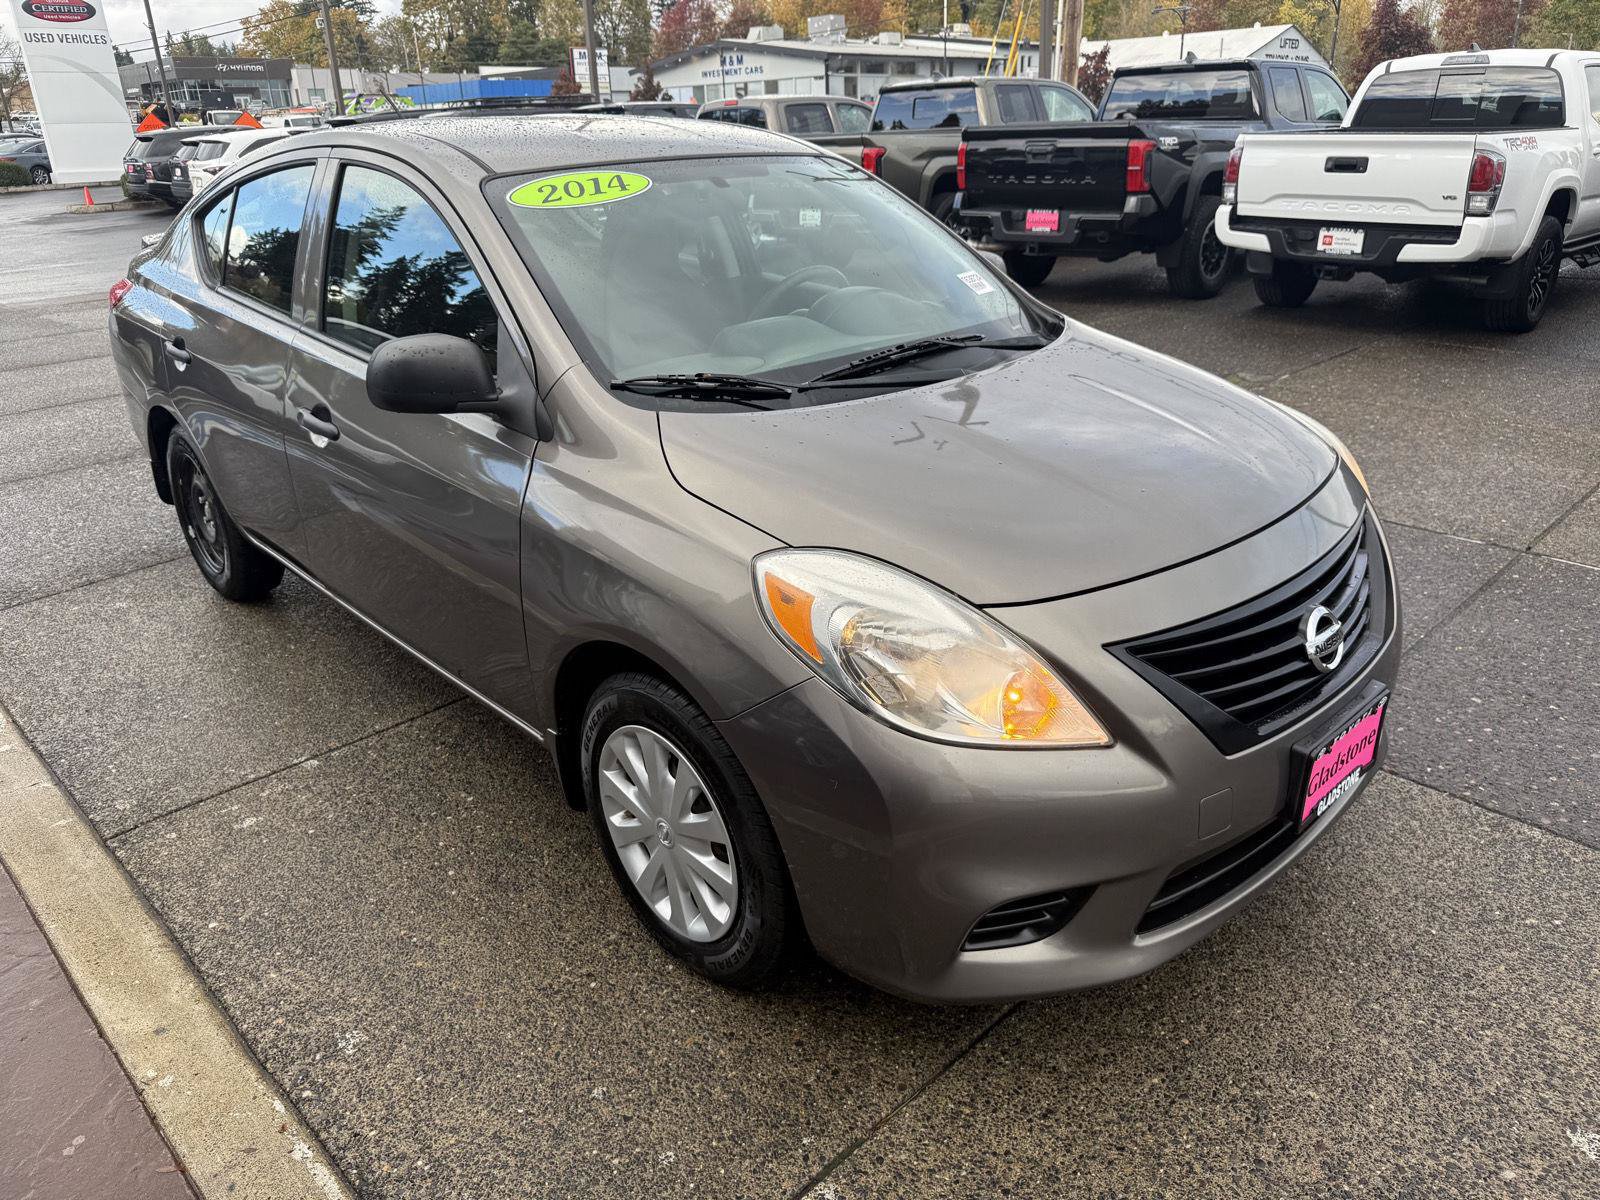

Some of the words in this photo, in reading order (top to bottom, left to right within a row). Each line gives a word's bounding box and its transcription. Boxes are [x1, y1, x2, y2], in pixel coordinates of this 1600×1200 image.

[32, 4, 88, 13] CERTIFIED
[24, 32, 54, 43] USED
[56, 33, 108, 45] VEHICLES
[1279, 37, 1299, 49] LIFTED
[736, 54, 744, 65] M
[701, 67, 742, 78] INVESTMENT
[744, 65, 764, 75] CARS
[987, 175, 1096, 184] TACOMA
[537, 174, 631, 204] 2014
[1280, 201, 1411, 215] TACOMA
[1307, 728, 1377, 798] Gladstone
[1316, 766, 1361, 817] GLADSTONE
